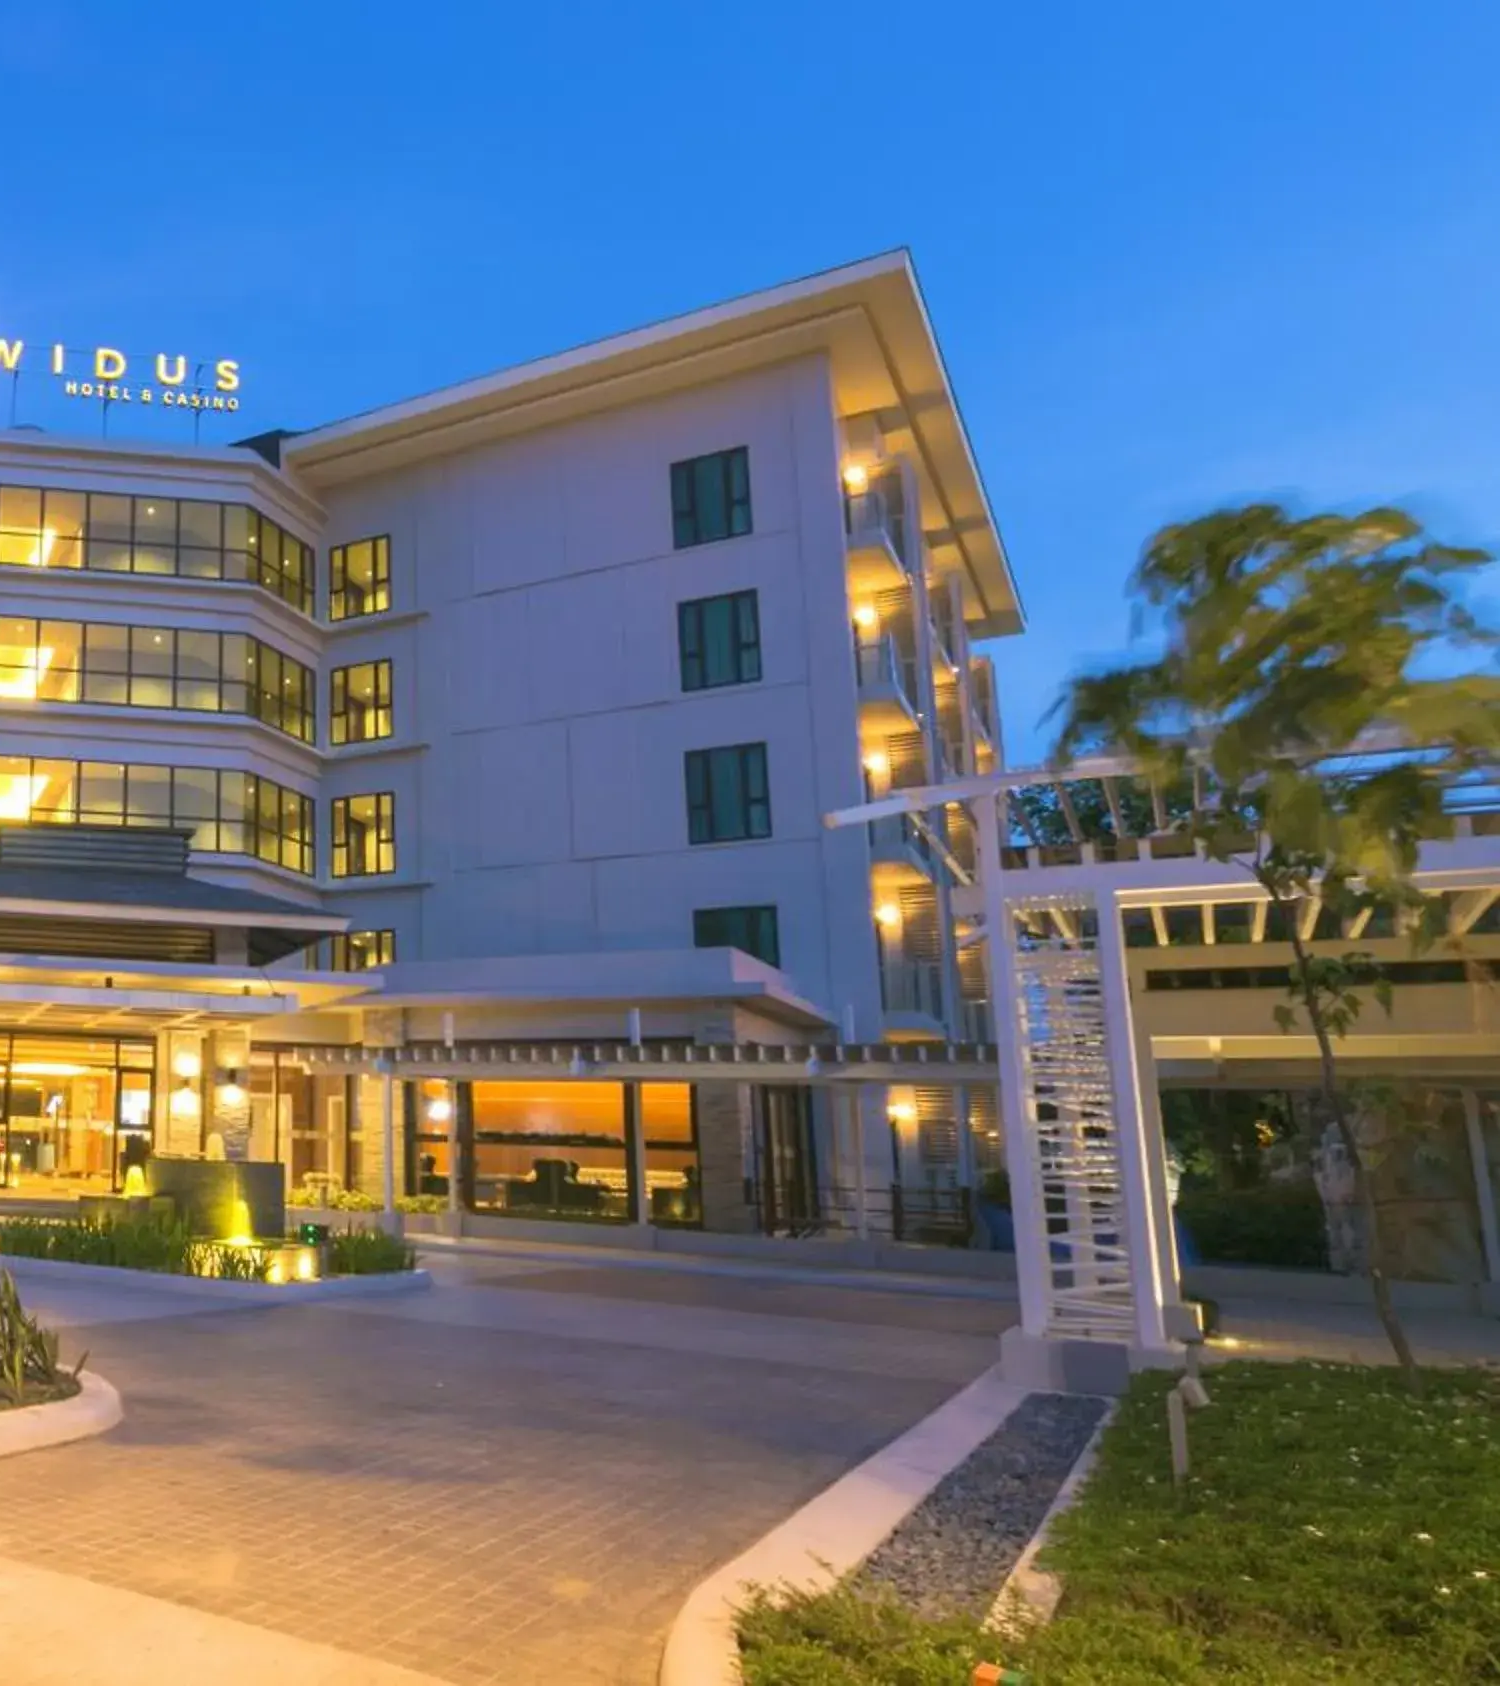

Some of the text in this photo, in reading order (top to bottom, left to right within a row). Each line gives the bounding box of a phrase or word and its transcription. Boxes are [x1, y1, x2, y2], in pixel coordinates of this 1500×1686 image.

[65, 381, 239, 412] HOTEL & CASINO
